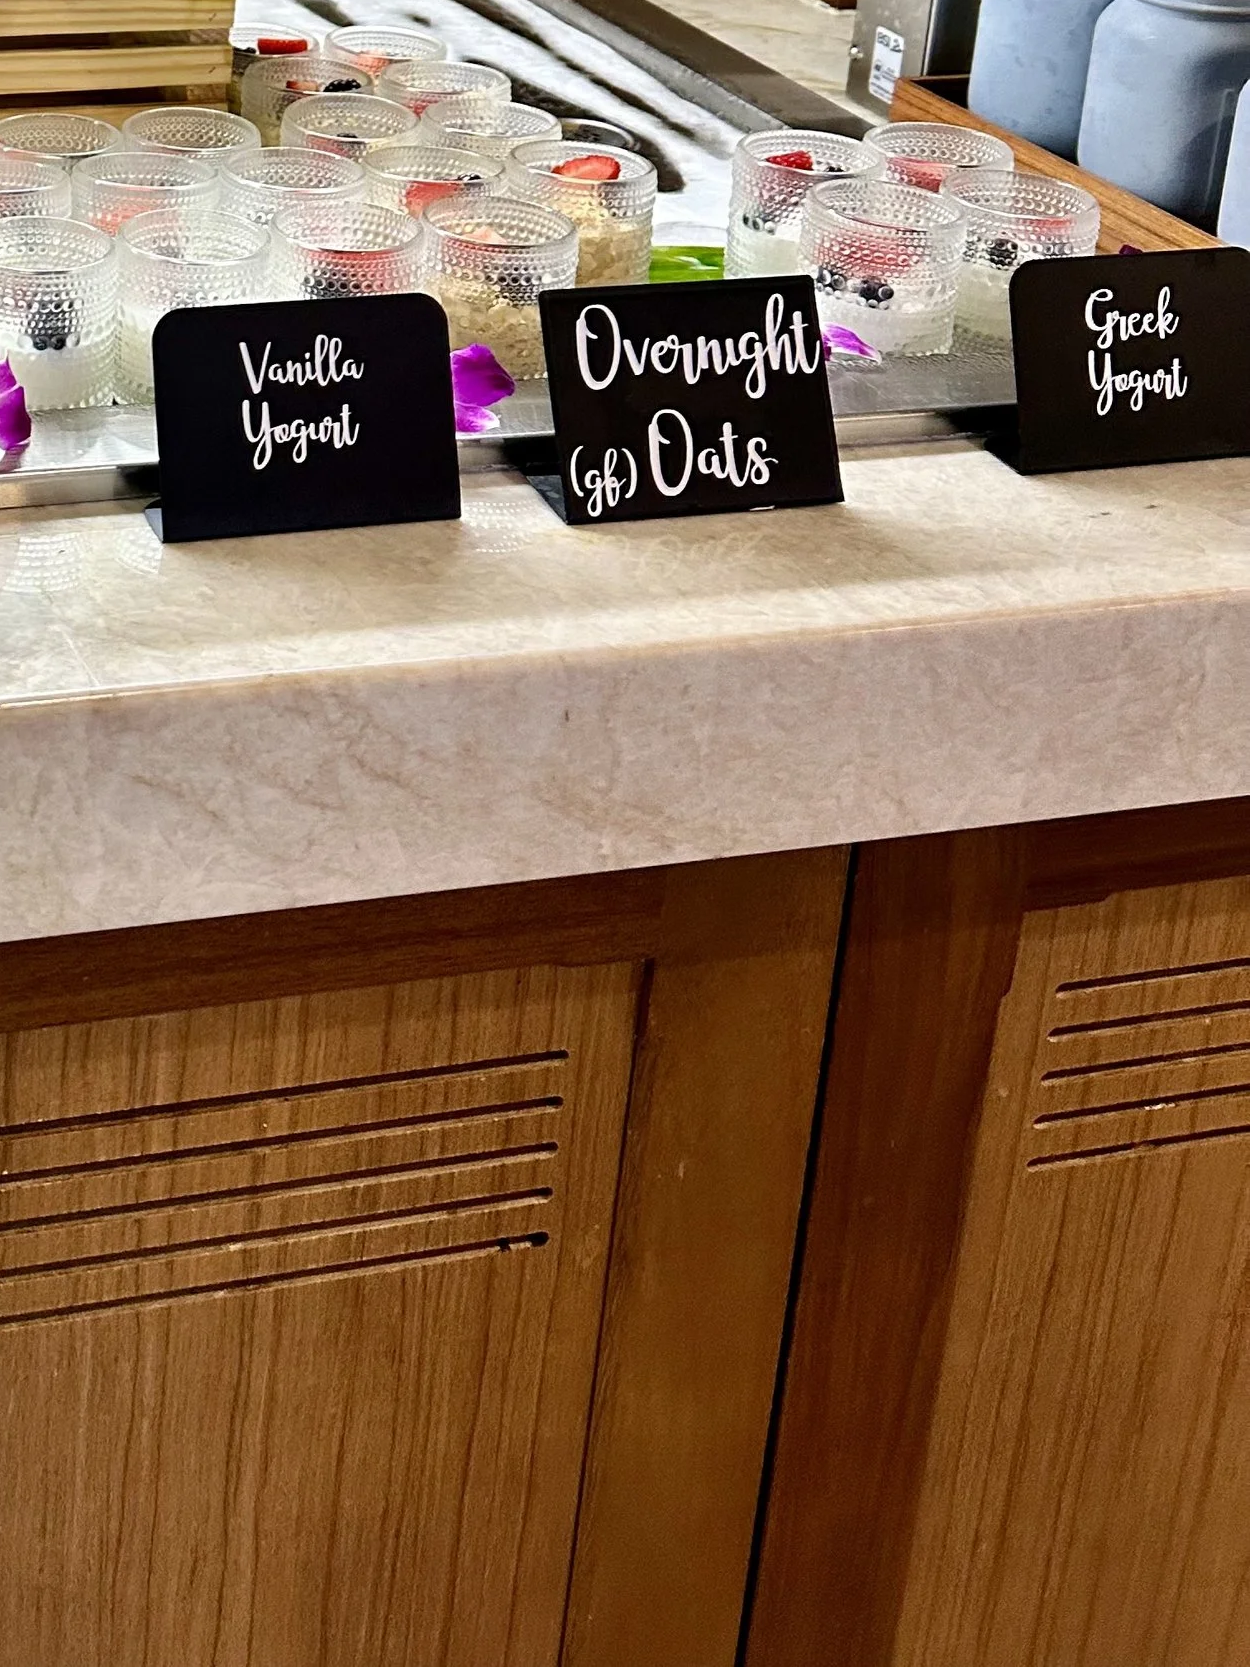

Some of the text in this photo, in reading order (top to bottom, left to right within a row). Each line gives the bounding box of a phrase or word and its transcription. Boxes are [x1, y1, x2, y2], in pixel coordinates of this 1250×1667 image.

[575, 292, 821, 399] Overnight
[1084, 286, 1180, 350] Greek
[239, 334, 364, 395] Vanilla
[1087, 349, 1188, 416] Yogurt
[241, 399, 361, 470] Yogurt
[570, 408, 779, 517] (gf) Oats
